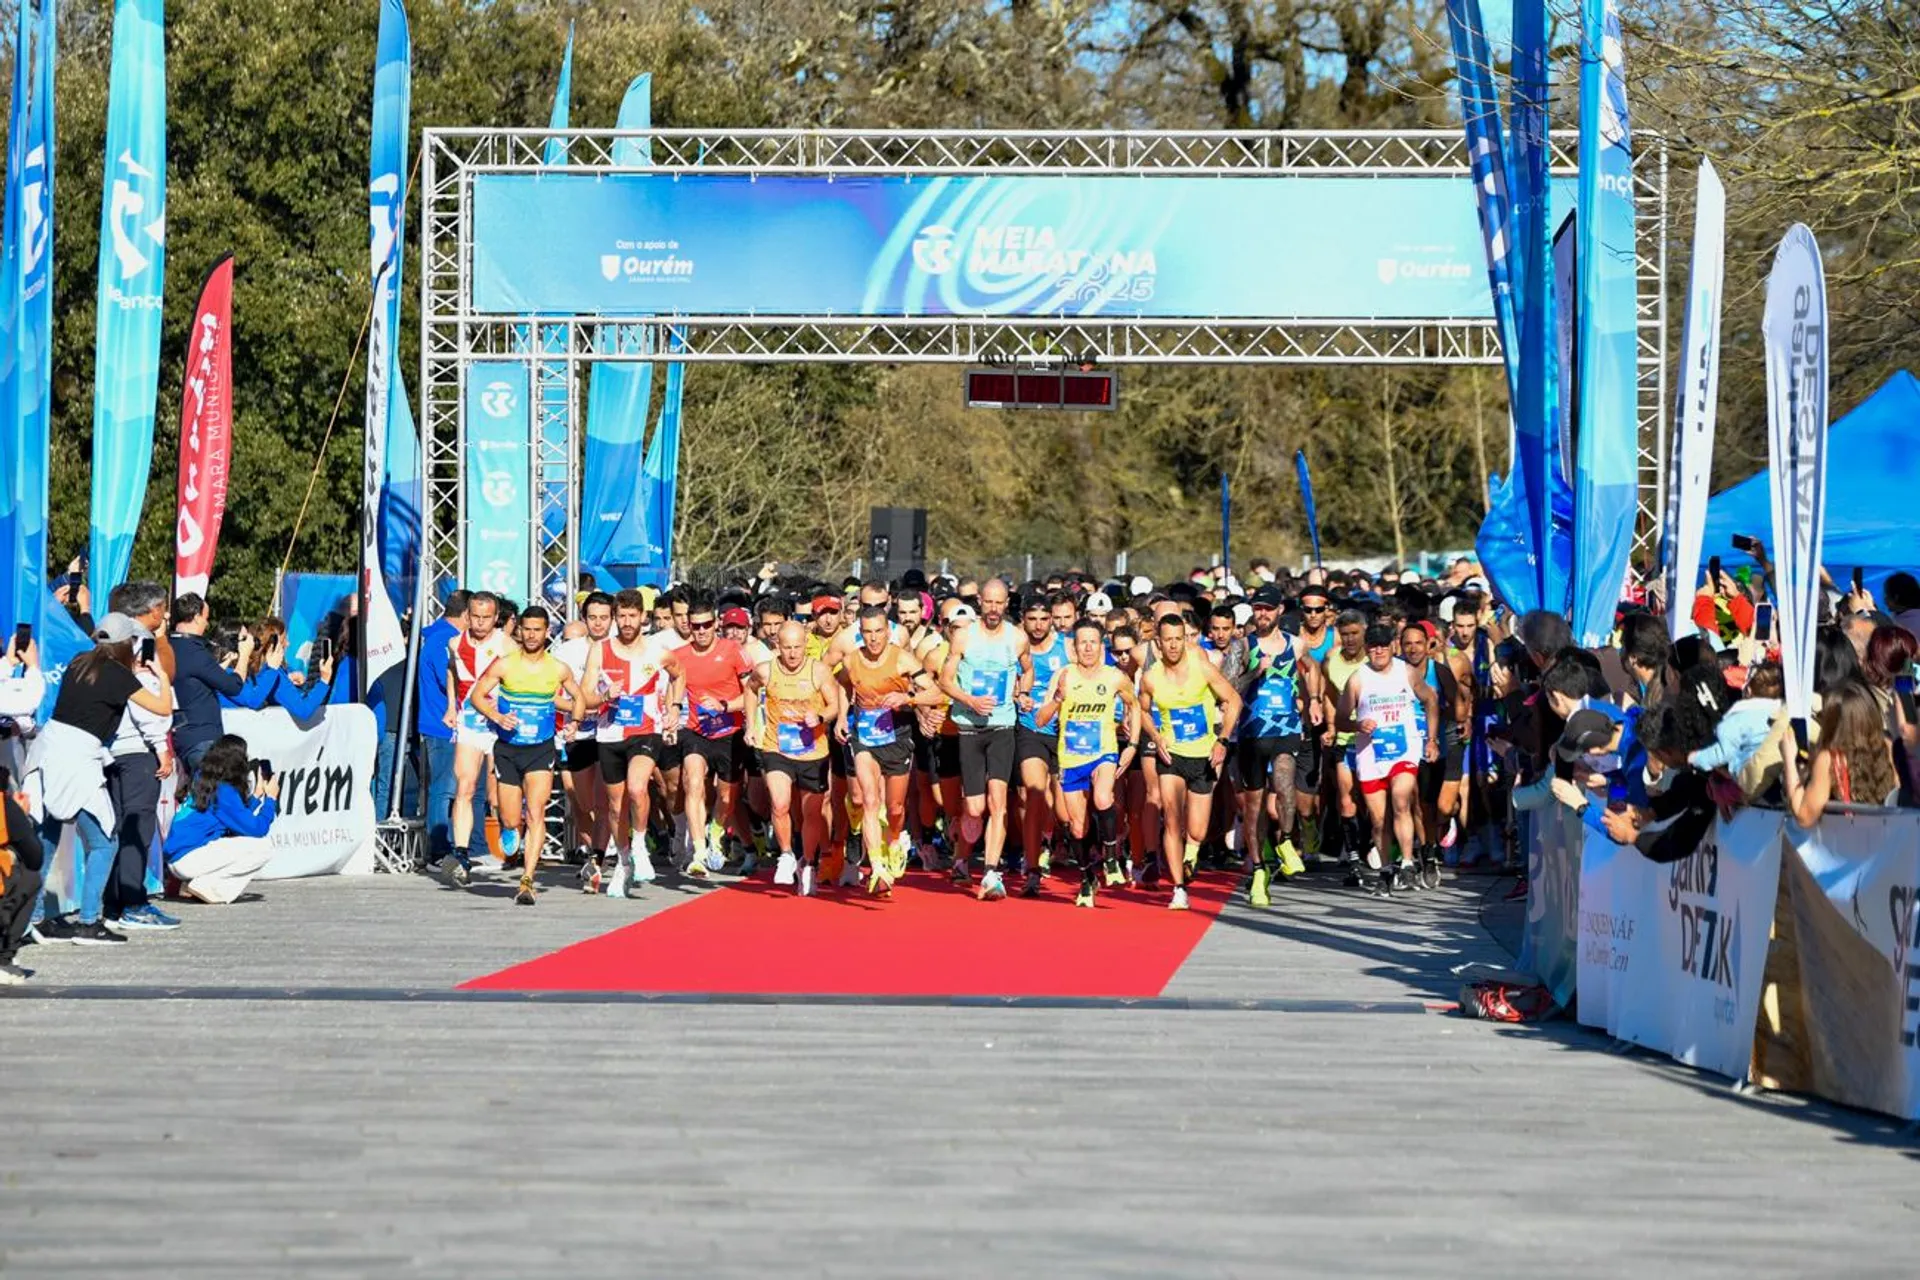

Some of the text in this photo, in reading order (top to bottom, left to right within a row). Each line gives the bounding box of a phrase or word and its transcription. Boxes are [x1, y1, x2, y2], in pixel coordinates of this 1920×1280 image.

[668, 239, 679, 249] de
[974, 226, 1055, 251] MEIA
[624, 254, 694, 275] Ourém
[1056, 276, 1155, 302] 2025
[1068, 702, 1106, 713] jmm
[293, 828, 354, 848] MUNICIPAL
